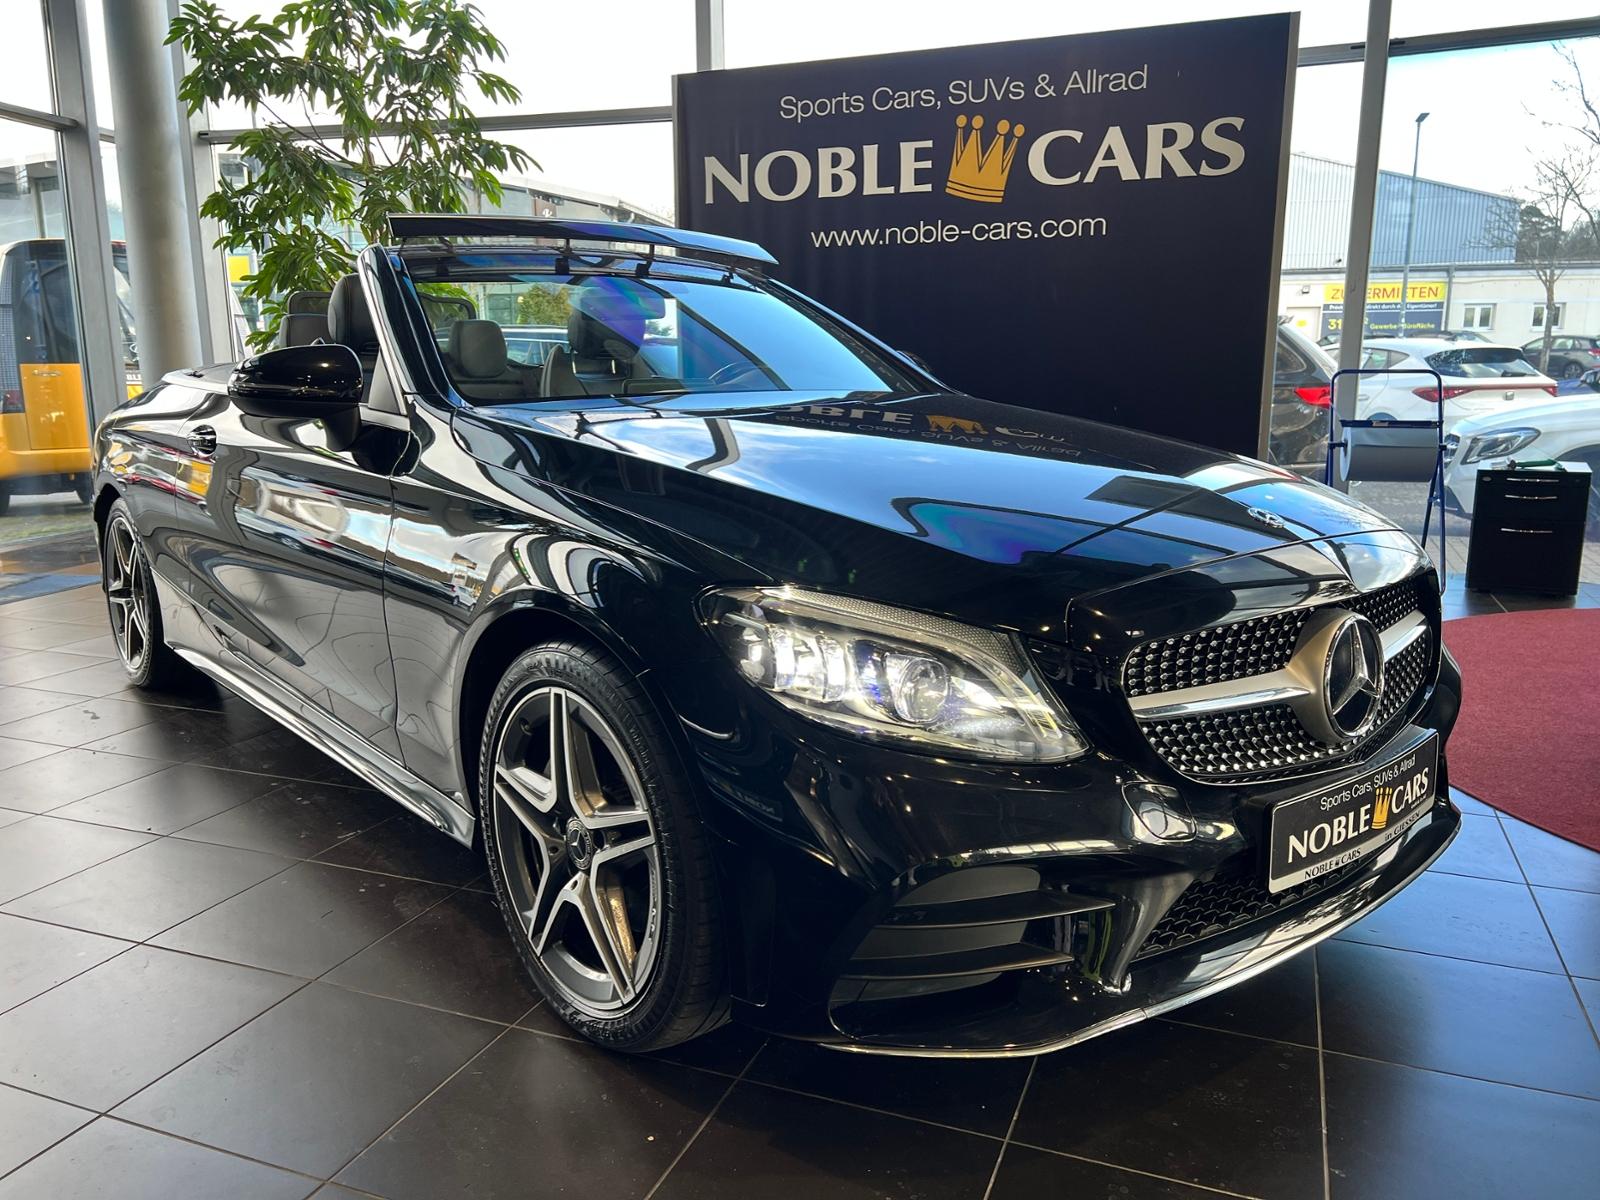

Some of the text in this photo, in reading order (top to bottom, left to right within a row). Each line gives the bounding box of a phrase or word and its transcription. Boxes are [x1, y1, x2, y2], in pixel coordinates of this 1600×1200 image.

[780, 64, 1148, 123] Sports Cars, SUVs & Allrad
[704, 117, 1246, 205] NOBLE CARS
[811, 217, 1107, 248] www.noble-cars.com
[1366, 286, 1440, 300] ERMITEN
[1320, 753, 1416, 811] Sports Cars, SUVs & Allrad
[1288, 767, 1429, 863] NOBLE CARS
[1304, 847, 1361, 880] NOBLE CARS
